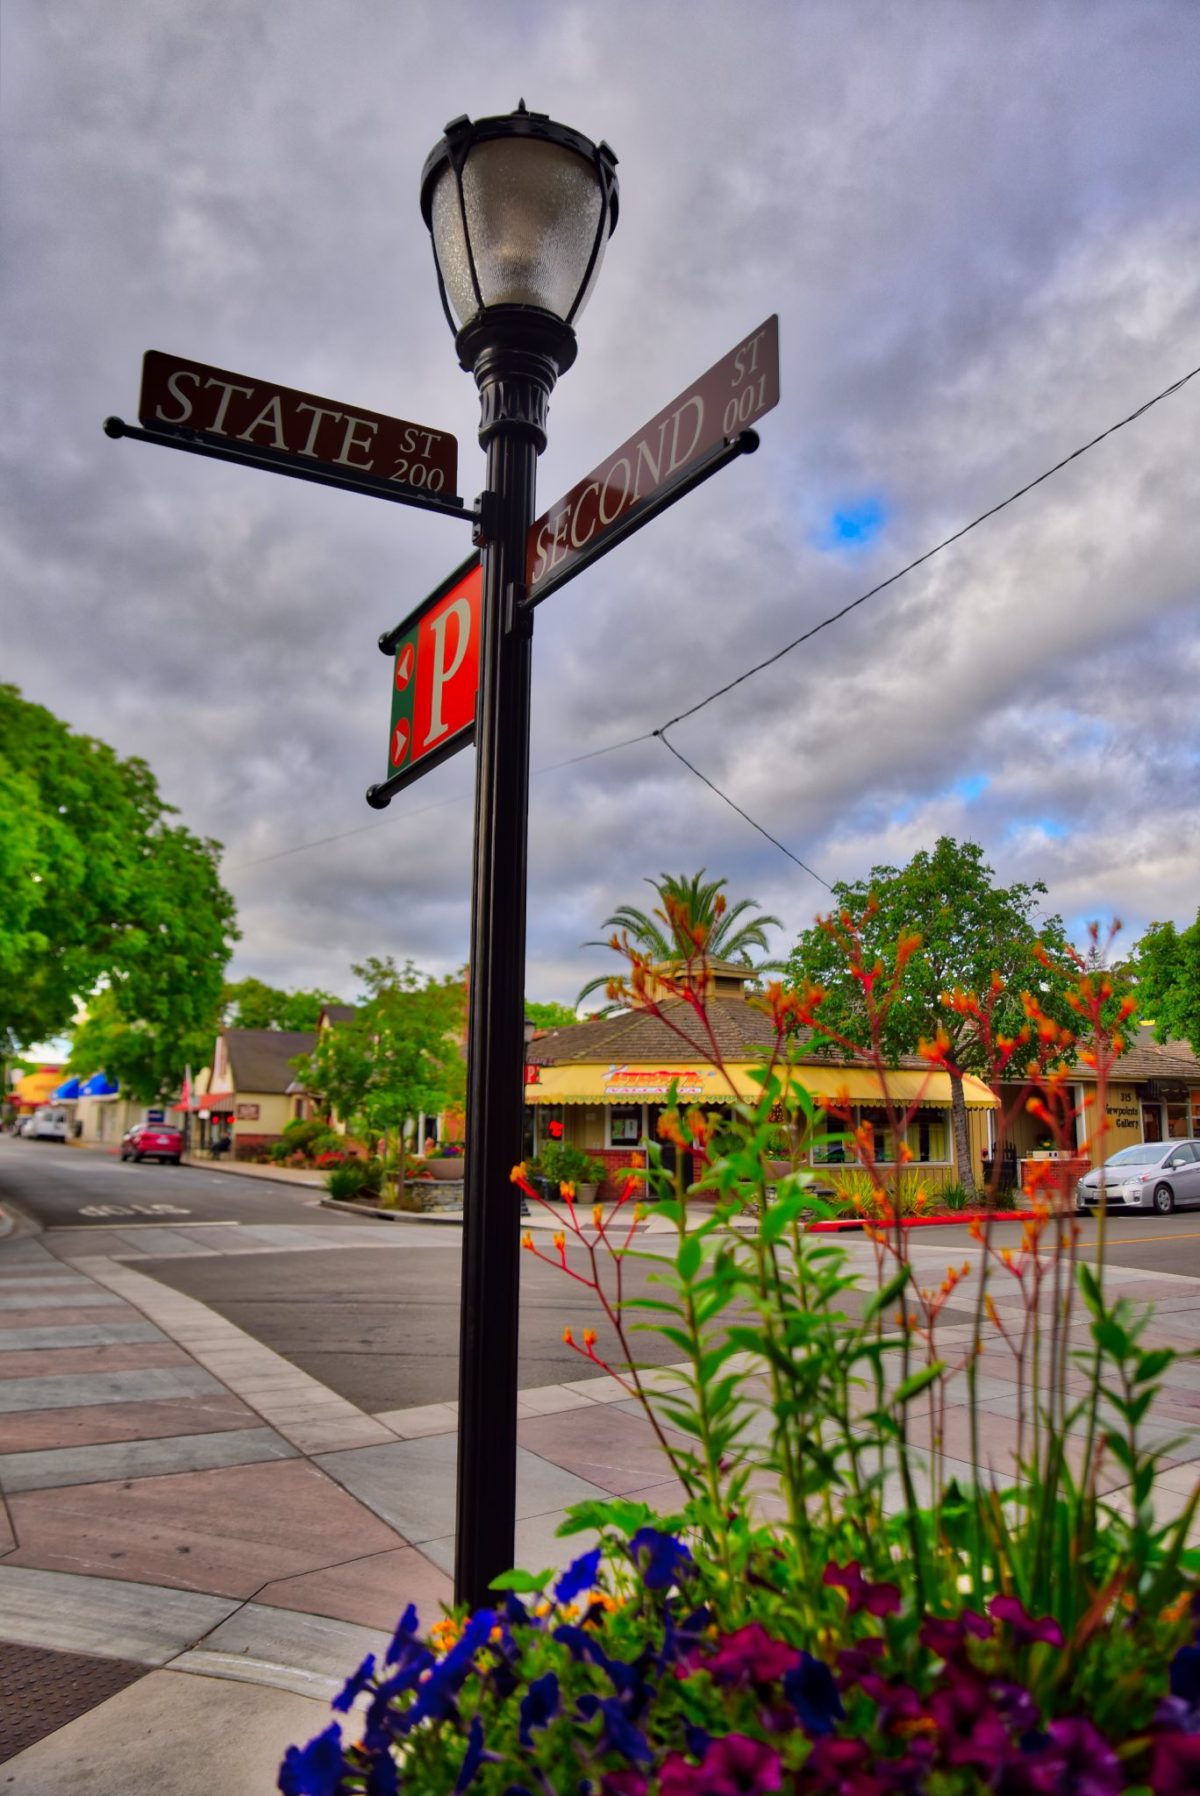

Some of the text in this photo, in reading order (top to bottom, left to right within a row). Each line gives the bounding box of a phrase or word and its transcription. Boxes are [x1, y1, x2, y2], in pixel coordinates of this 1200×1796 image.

[155, 370, 441, 471] STATE ST
[722, 373, 766, 434] 001
[388, 459, 445, 491] 200
[532, 331, 765, 584] SECOND ST
[423, 598, 471, 747] P
[1116, 1118, 1139, 1130] Gallery
[78, 1203, 192, 1218] STOP
